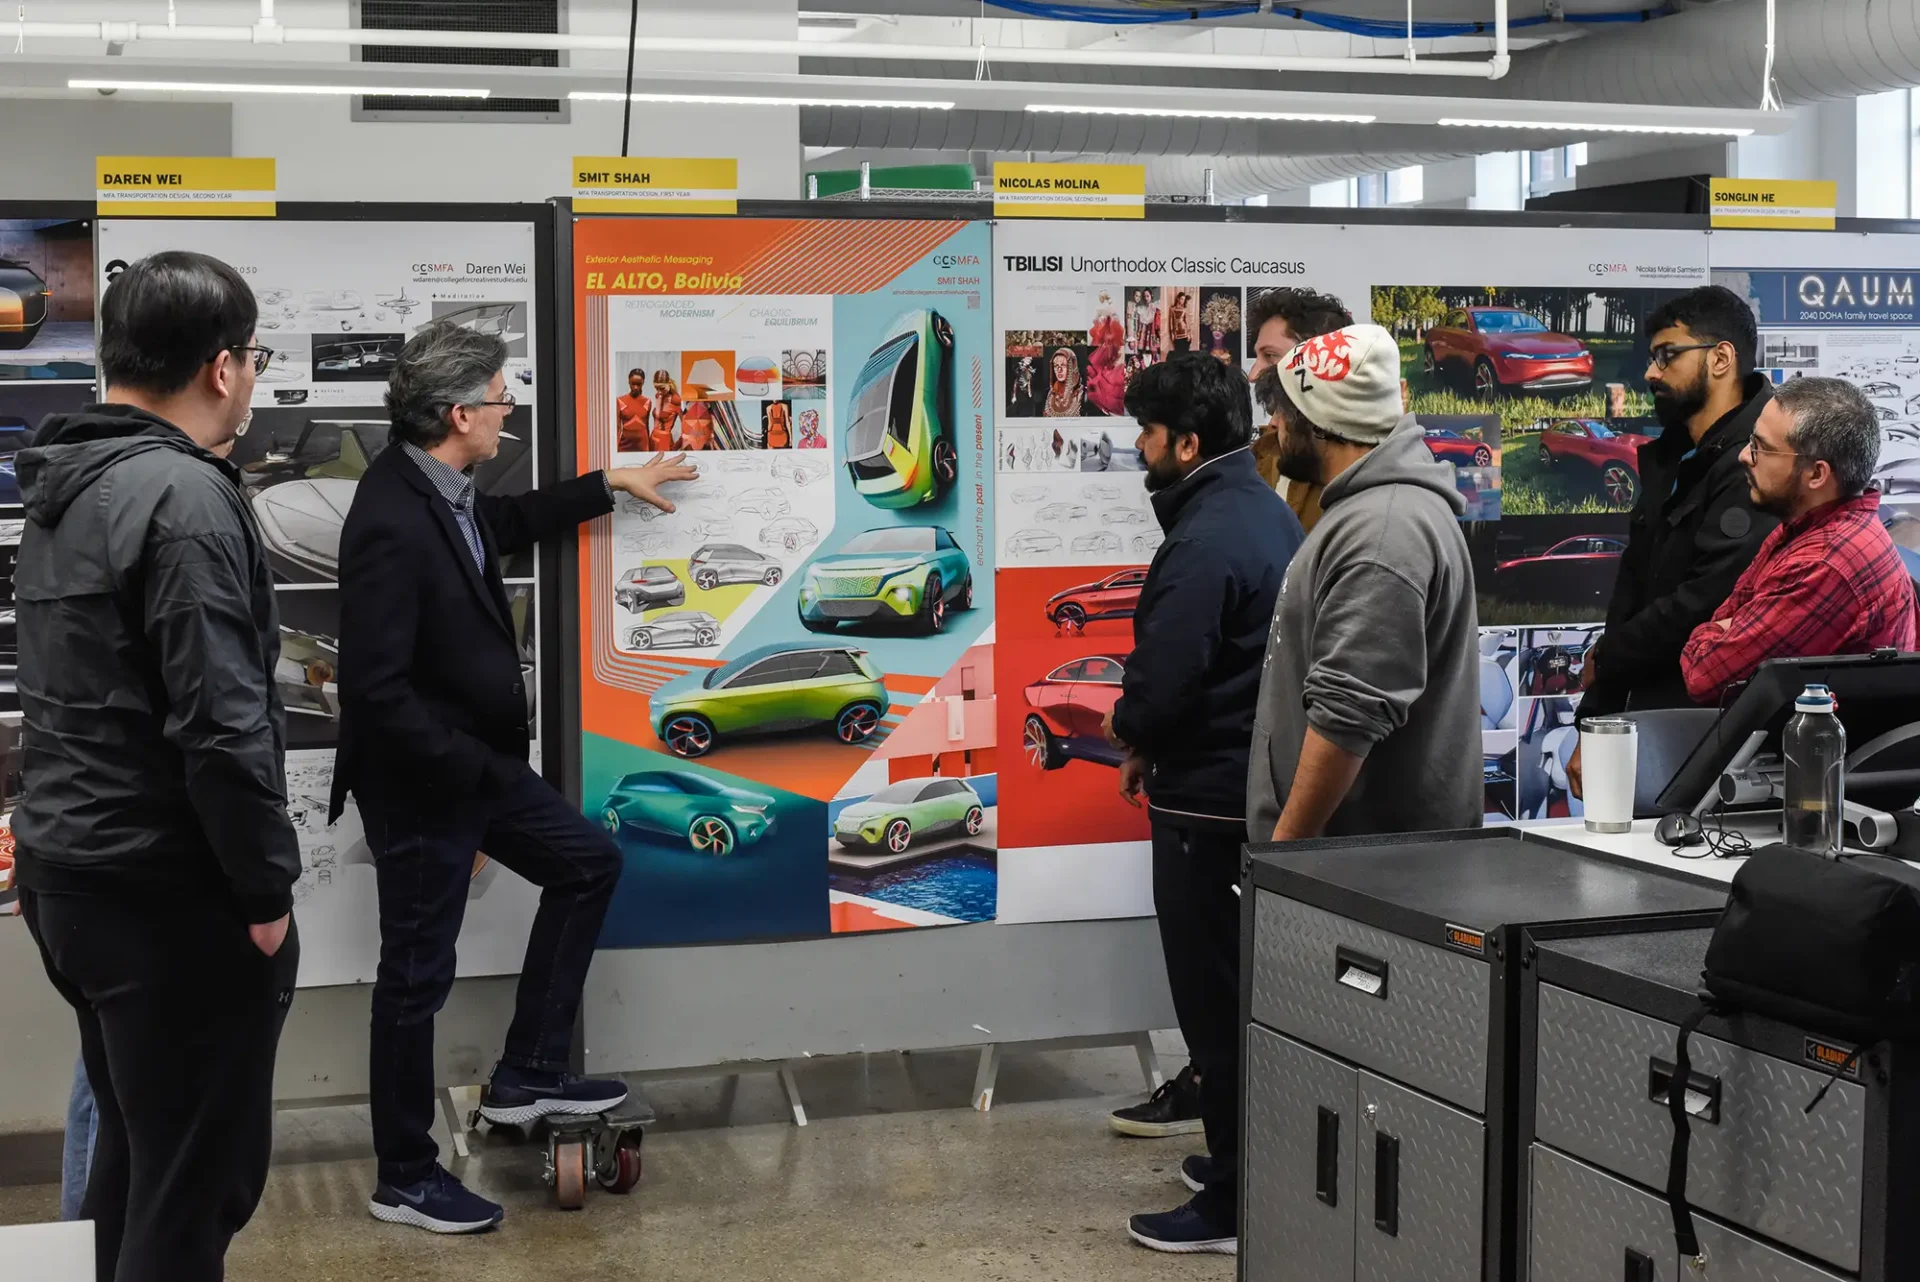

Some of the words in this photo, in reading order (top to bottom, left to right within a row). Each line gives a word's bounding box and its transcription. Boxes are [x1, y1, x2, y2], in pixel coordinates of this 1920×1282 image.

[103, 174, 152, 185] DAREN
[156, 174, 182, 185] WEI
[578, 172, 610, 183] SMIT
[614, 173, 650, 184] SHAH
[999, 178, 1050, 188] NICOLAS
[1054, 179, 1100, 190] MOLINA
[1714, 192, 1758, 202] SONGLIN
[1761, 194, 1775, 202] HE
[585, 256, 618, 264] Exterior
[620, 256, 662, 264] Aesthetic
[664, 256, 714, 266] Messaging
[933, 256, 980, 267] CCSMFA
[1003, 256, 1064, 272] TBILISI
[1070, 256, 1166, 272] Unorthodox
[1171, 257, 1226, 273] Classic
[1230, 258, 1306, 274] Caucasus
[412, 264, 454, 274] CCSMFA
[466, 263, 501, 274] Daren
[504, 263, 526, 274] Wei
[1588, 264, 1628, 274] CCSMFA
[586, 272, 606, 289] EL
[611, 272, 668, 292] ALTO,
[674, 272, 744, 290] Bolivia
[937, 277, 956, 285] SMIT
[957, 277, 980, 285] SHAH
[1800, 275, 1914, 307] QAUM
[625, 300, 695, 309] RETROGRADED
[660, 310, 716, 318] MODERNISM
[750, 309, 792, 317] CHAOTIC
[1800, 312, 1818, 320] 2040
[1819, 312, 1843, 320] DOHA
[1844, 311, 1868, 321] family
[1868, 312, 1889, 320] travel
[1890, 313, 1913, 322] space
[764, 318, 818, 326] EQUILIBRIUM
[974, 414, 984, 450] present
[975, 452, 983, 469] the
[975, 471, 983, 480] in
[976, 525, 984, 566] enchant
[1816, 1044, 1856, 1069] GLADIATR
